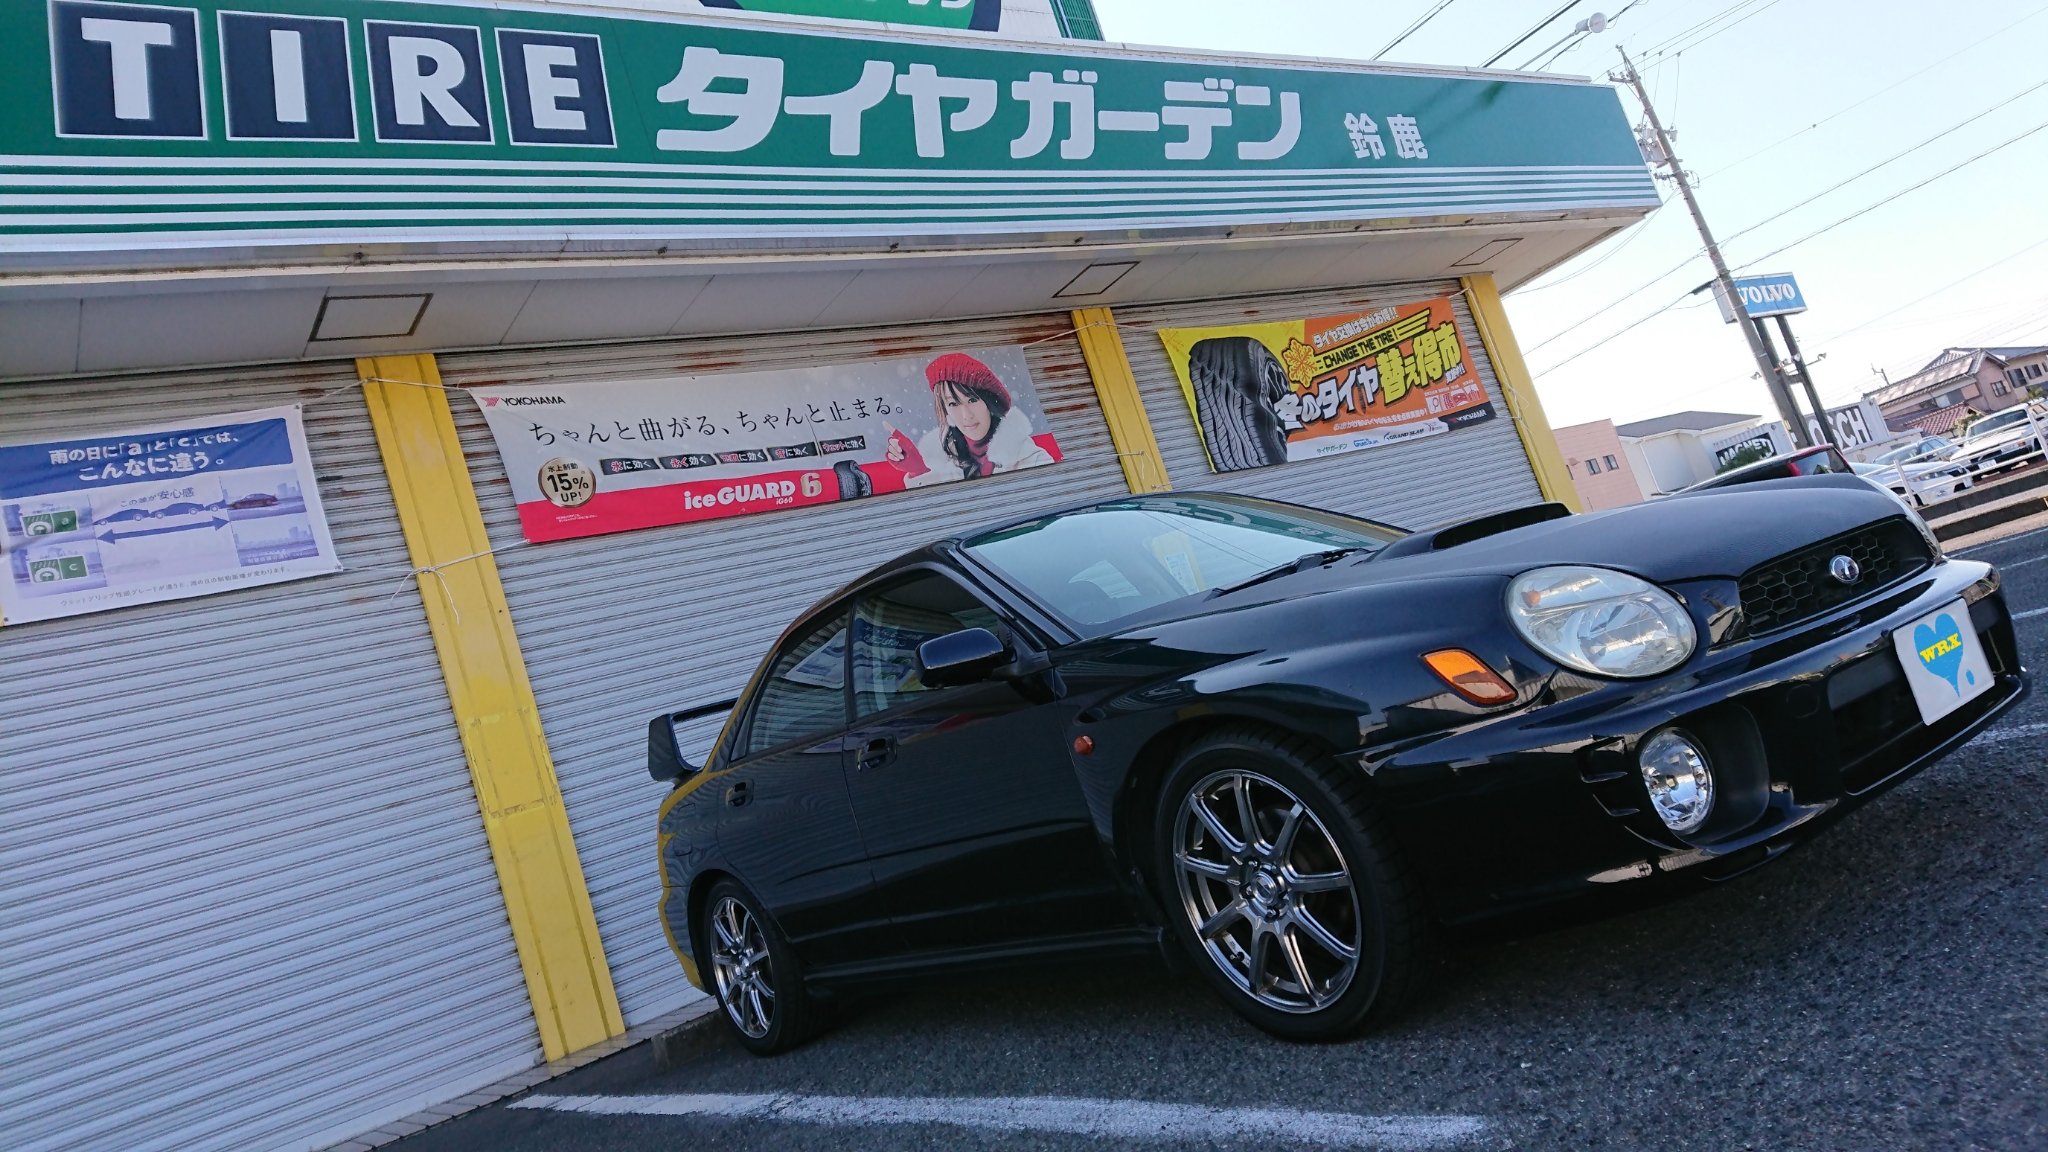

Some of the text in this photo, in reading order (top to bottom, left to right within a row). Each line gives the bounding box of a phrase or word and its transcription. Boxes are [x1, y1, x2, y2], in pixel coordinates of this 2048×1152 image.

[81, 19, 1428, 160] TIRE タイヤガーデン 鈴鹿
[1737, 283, 1795, 305] VOLVO
[1323, 345, 1359, 368] CHANGE
[1358, 338, 1376, 352] THE
[501, 396, 566, 407] YOKOHAMA
[822, 438, 864, 452] ウェットに効く
[774, 447, 808, 459] 音に効く
[78, 451, 225, 481] こんなに違う。
[547, 462, 578, 473] 氷上制動
[610, 460, 651, 472] 氷に効く
[670, 456, 707, 468] 永く効く
[547, 473, 590, 493] 15%
[800, 472, 823, 498] 6
[561, 491, 582, 503] UP!
